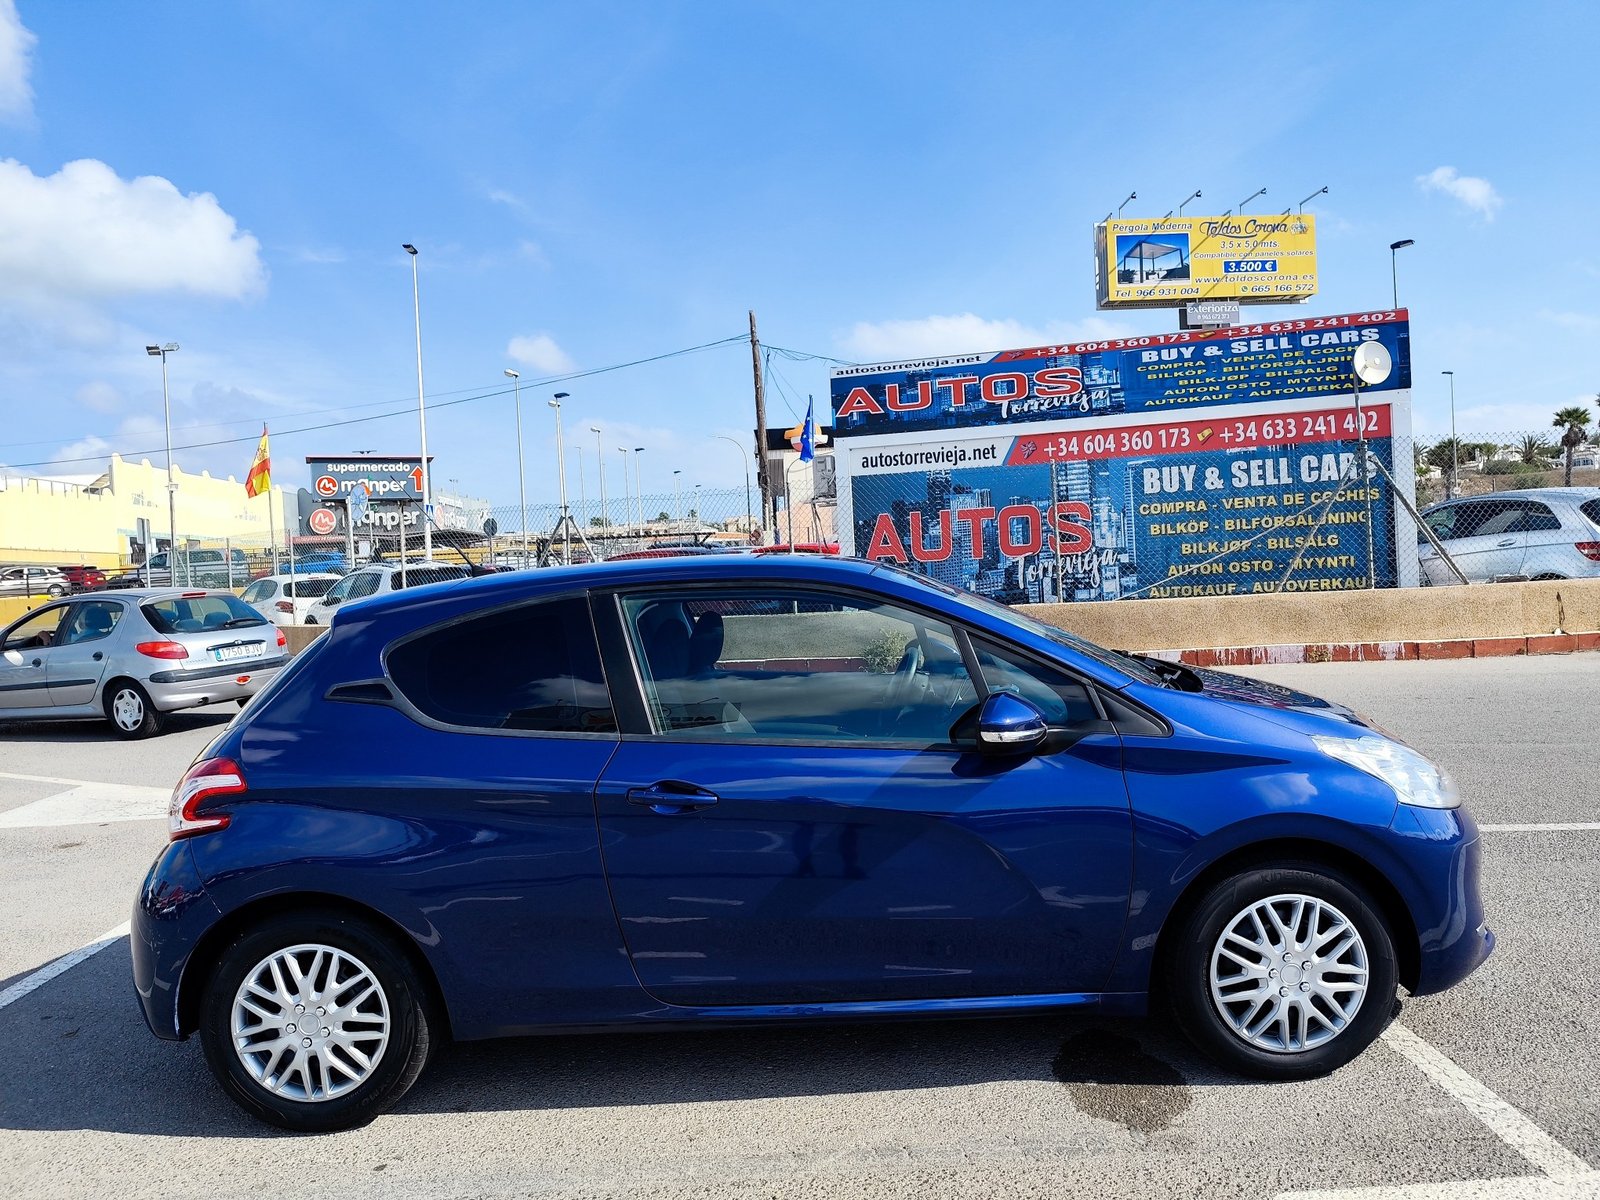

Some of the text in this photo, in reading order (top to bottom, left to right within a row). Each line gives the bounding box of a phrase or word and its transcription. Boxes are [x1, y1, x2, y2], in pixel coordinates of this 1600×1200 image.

[1151, 222, 1193, 231] Moderna
[1199, 219, 1289, 238] Toldos Corona
[1193, 251, 1237, 259] Compatible
[1228, 261, 1274, 272] 3.500 €
[1195, 274, 1314, 284] www.toldoscorona.es
[1251, 285, 1271, 293] 665
[1274, 284, 1293, 292] 166
[1136, 289, 1156, 297] 966
[1158, 288, 1177, 296] 931
[1180, 287, 1200, 295] 004
[1187, 303, 1239, 314] exterioriza
[1223, 312, 1397, 337] +34 633 241 402
[1032, 334, 1191, 356] +34 604 360 173
[1141, 327, 1380, 363] BUY & SELL CARS
[836, 354, 981, 376] autostorrevieja.net
[1137, 360, 1206, 372] COMPRA
[1221, 353, 1277, 364] VENTA
[1282, 350, 1305, 358] DE
[1310, 345, 1359, 355] COCH
[1147, 369, 1207, 380] BILKÖP
[1223, 355, 1353, 373] BILFÖRSÄLJNIN
[1164, 385, 1221, 396] AUTON
[1226, 380, 1271, 390] OSTO
[1287, 374, 1355, 386] MYYNTI
[1178, 374, 1250, 386] BILKJØP
[1265, 366, 1338, 378] BILSALG
[835, 367, 1083, 417] AUTOS
[1144, 393, 1233, 406] AUTOKAUF
[995, 388, 1109, 419] Torrevieja
[1219, 411, 1379, 443] +34 633 241 402
[1043, 428, 1191, 457] +34 604 360 173
[861, 443, 997, 469] autostorrevieja.net
[327, 462, 411, 474] supermercado
[1143, 464, 1197, 494] BUY
[1204, 466, 1224, 489] &
[1231, 457, 1293, 488] SELL
[1139, 500, 1207, 515] COMPRA
[1223, 495, 1276, 510] VENTA
[1283, 493, 1305, 506] DE
[1310, 488, 1380, 504] COCHES
[342, 511, 420, 531] anper
[1150, 520, 1209, 536] BILKÖP
[866, 501, 1093, 564] AUTOS
[1267, 535, 1339, 550] BILSALG
[1013, 547, 1119, 590] Torrevieja
[1168, 562, 1223, 577] AUTON
[1228, 560, 1274, 574] OSTO
[1290, 556, 1355, 570] MYYNTI
[1149, 583, 1237, 598] AUTOKAUF
[1253, 577, 1368, 594] AUOVERKAU
[221, 646, 243, 658] 1750
